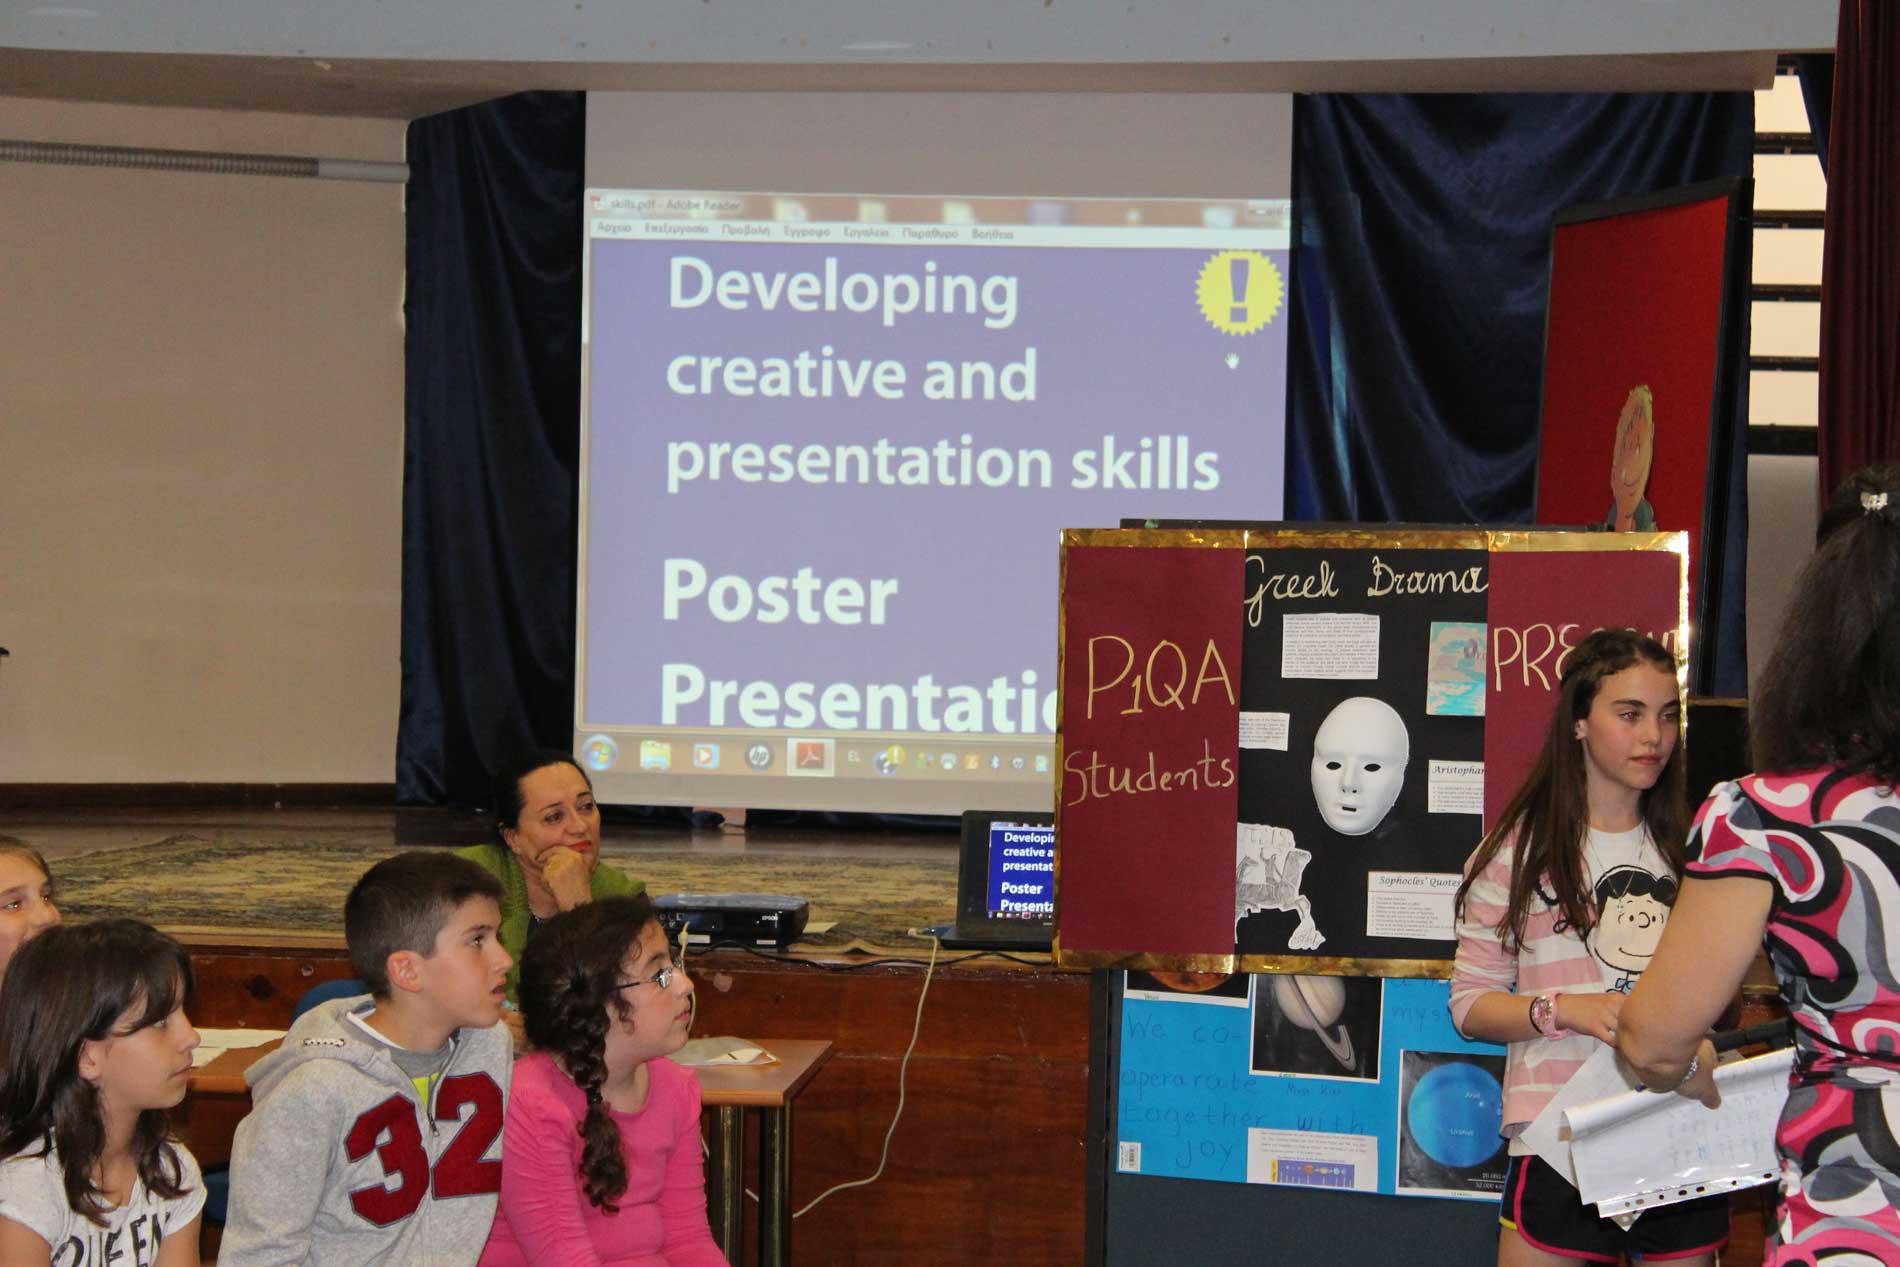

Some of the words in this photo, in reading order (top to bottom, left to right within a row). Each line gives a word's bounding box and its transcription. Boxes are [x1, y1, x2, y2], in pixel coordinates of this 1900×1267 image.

[610, 200, 656, 212] skills.pdf
[666, 199, 700, 211] Adobe
[703, 199, 741, 211] Reader
[669, 255, 1018, 329] Developing
[666, 345, 906, 399] creative
[923, 346, 1037, 401] and
[667, 433, 1052, 493] presentation
[1071, 435, 1220, 490] skills
[663, 557, 898, 625] Poster
[1244, 555, 1339, 627] Greek
[1367, 555, 1489, 597] Drama
[1064, 738, 1236, 807] Students
[1003, 847, 1045, 857] creative
[1003, 862, 1054, 872] presentat
[1001, 882, 1043, 894] Poster
[1429, 878, 1462, 888] Quotes
[1127, 1013, 1167, 1039] We
[343, 1071, 503, 1229] 32
